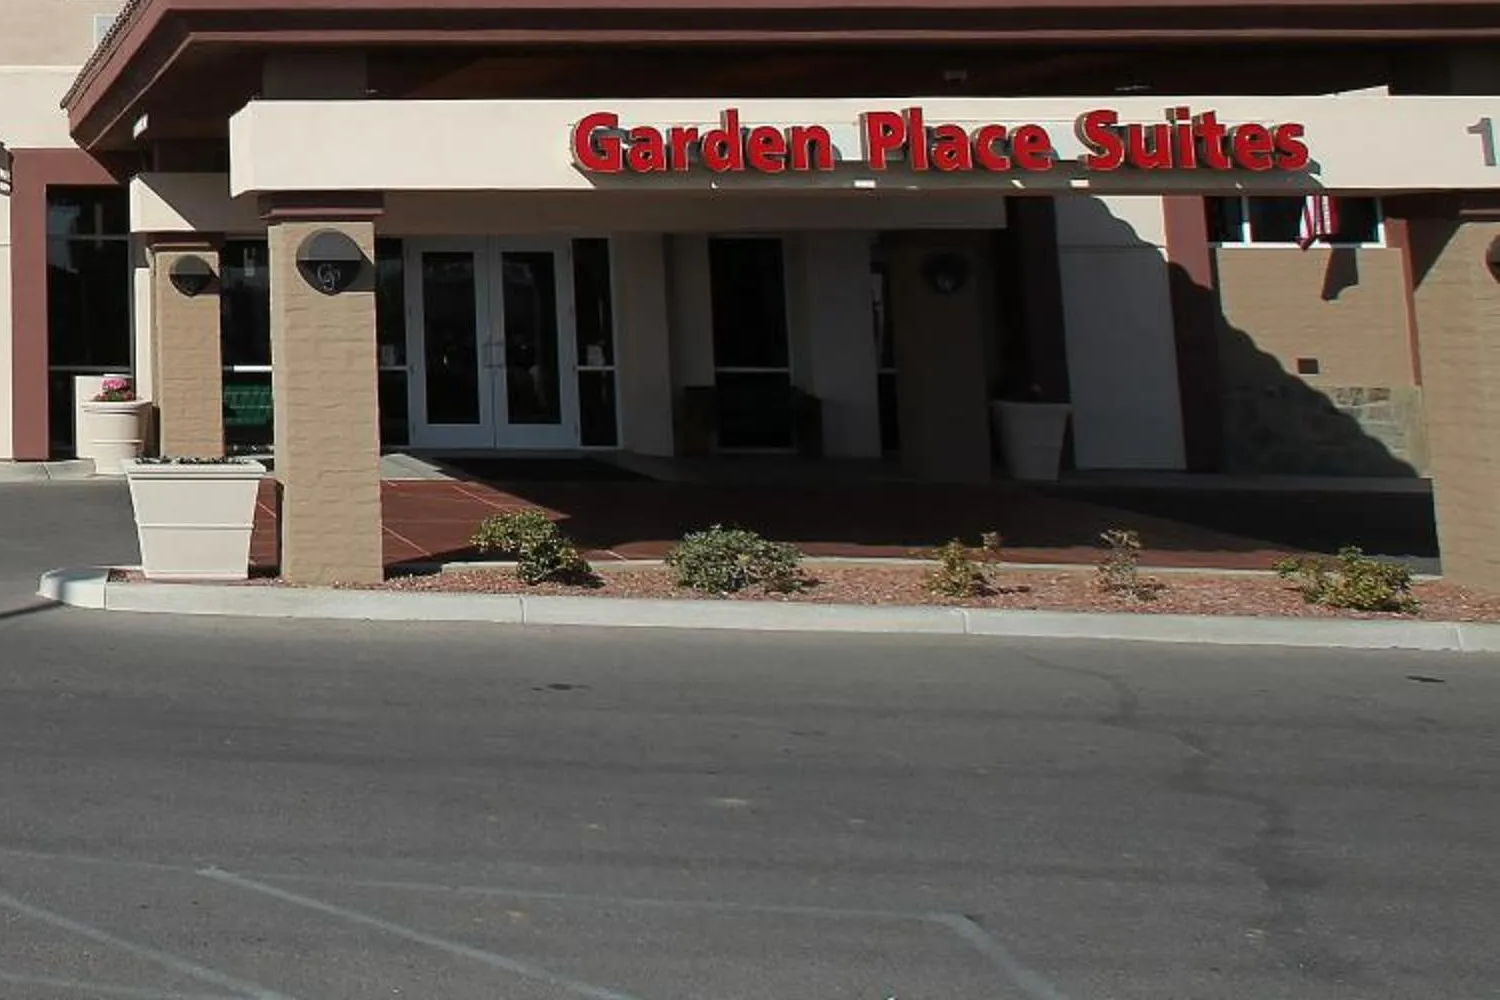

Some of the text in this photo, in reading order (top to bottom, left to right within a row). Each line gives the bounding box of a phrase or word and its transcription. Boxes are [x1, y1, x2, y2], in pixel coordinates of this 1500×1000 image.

[572, 106, 1309, 172] Garden Place Suites
[1467, 117, 1497, 167] 1
